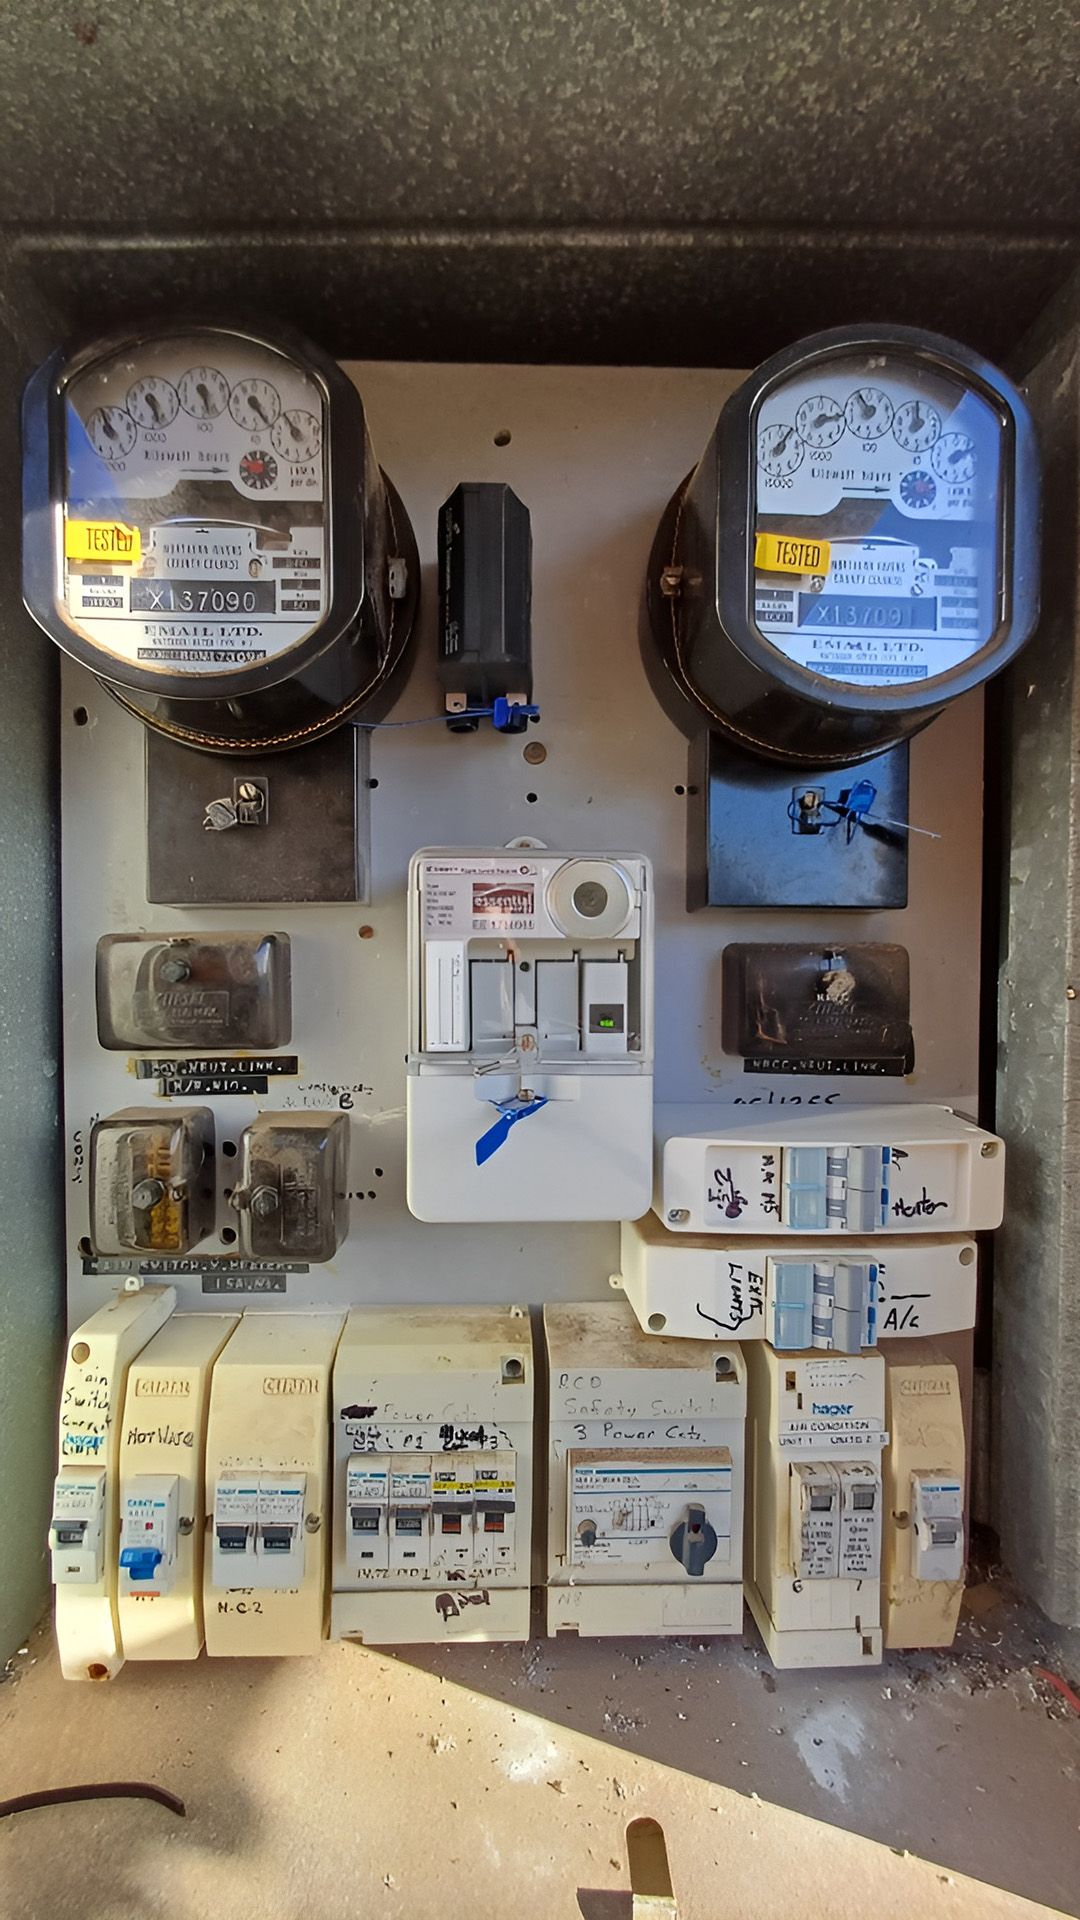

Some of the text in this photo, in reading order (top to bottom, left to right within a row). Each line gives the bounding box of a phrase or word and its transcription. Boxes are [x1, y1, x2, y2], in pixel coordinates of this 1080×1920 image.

[87, 528, 132, 552] TESTED
[776, 541, 820, 567] TESTED
[149, 591, 256, 612] X137090
[811, 1402, 854, 1417] hager
[573, 1424, 588, 1440] 3
[603, 1422, 656, 1440] Power
